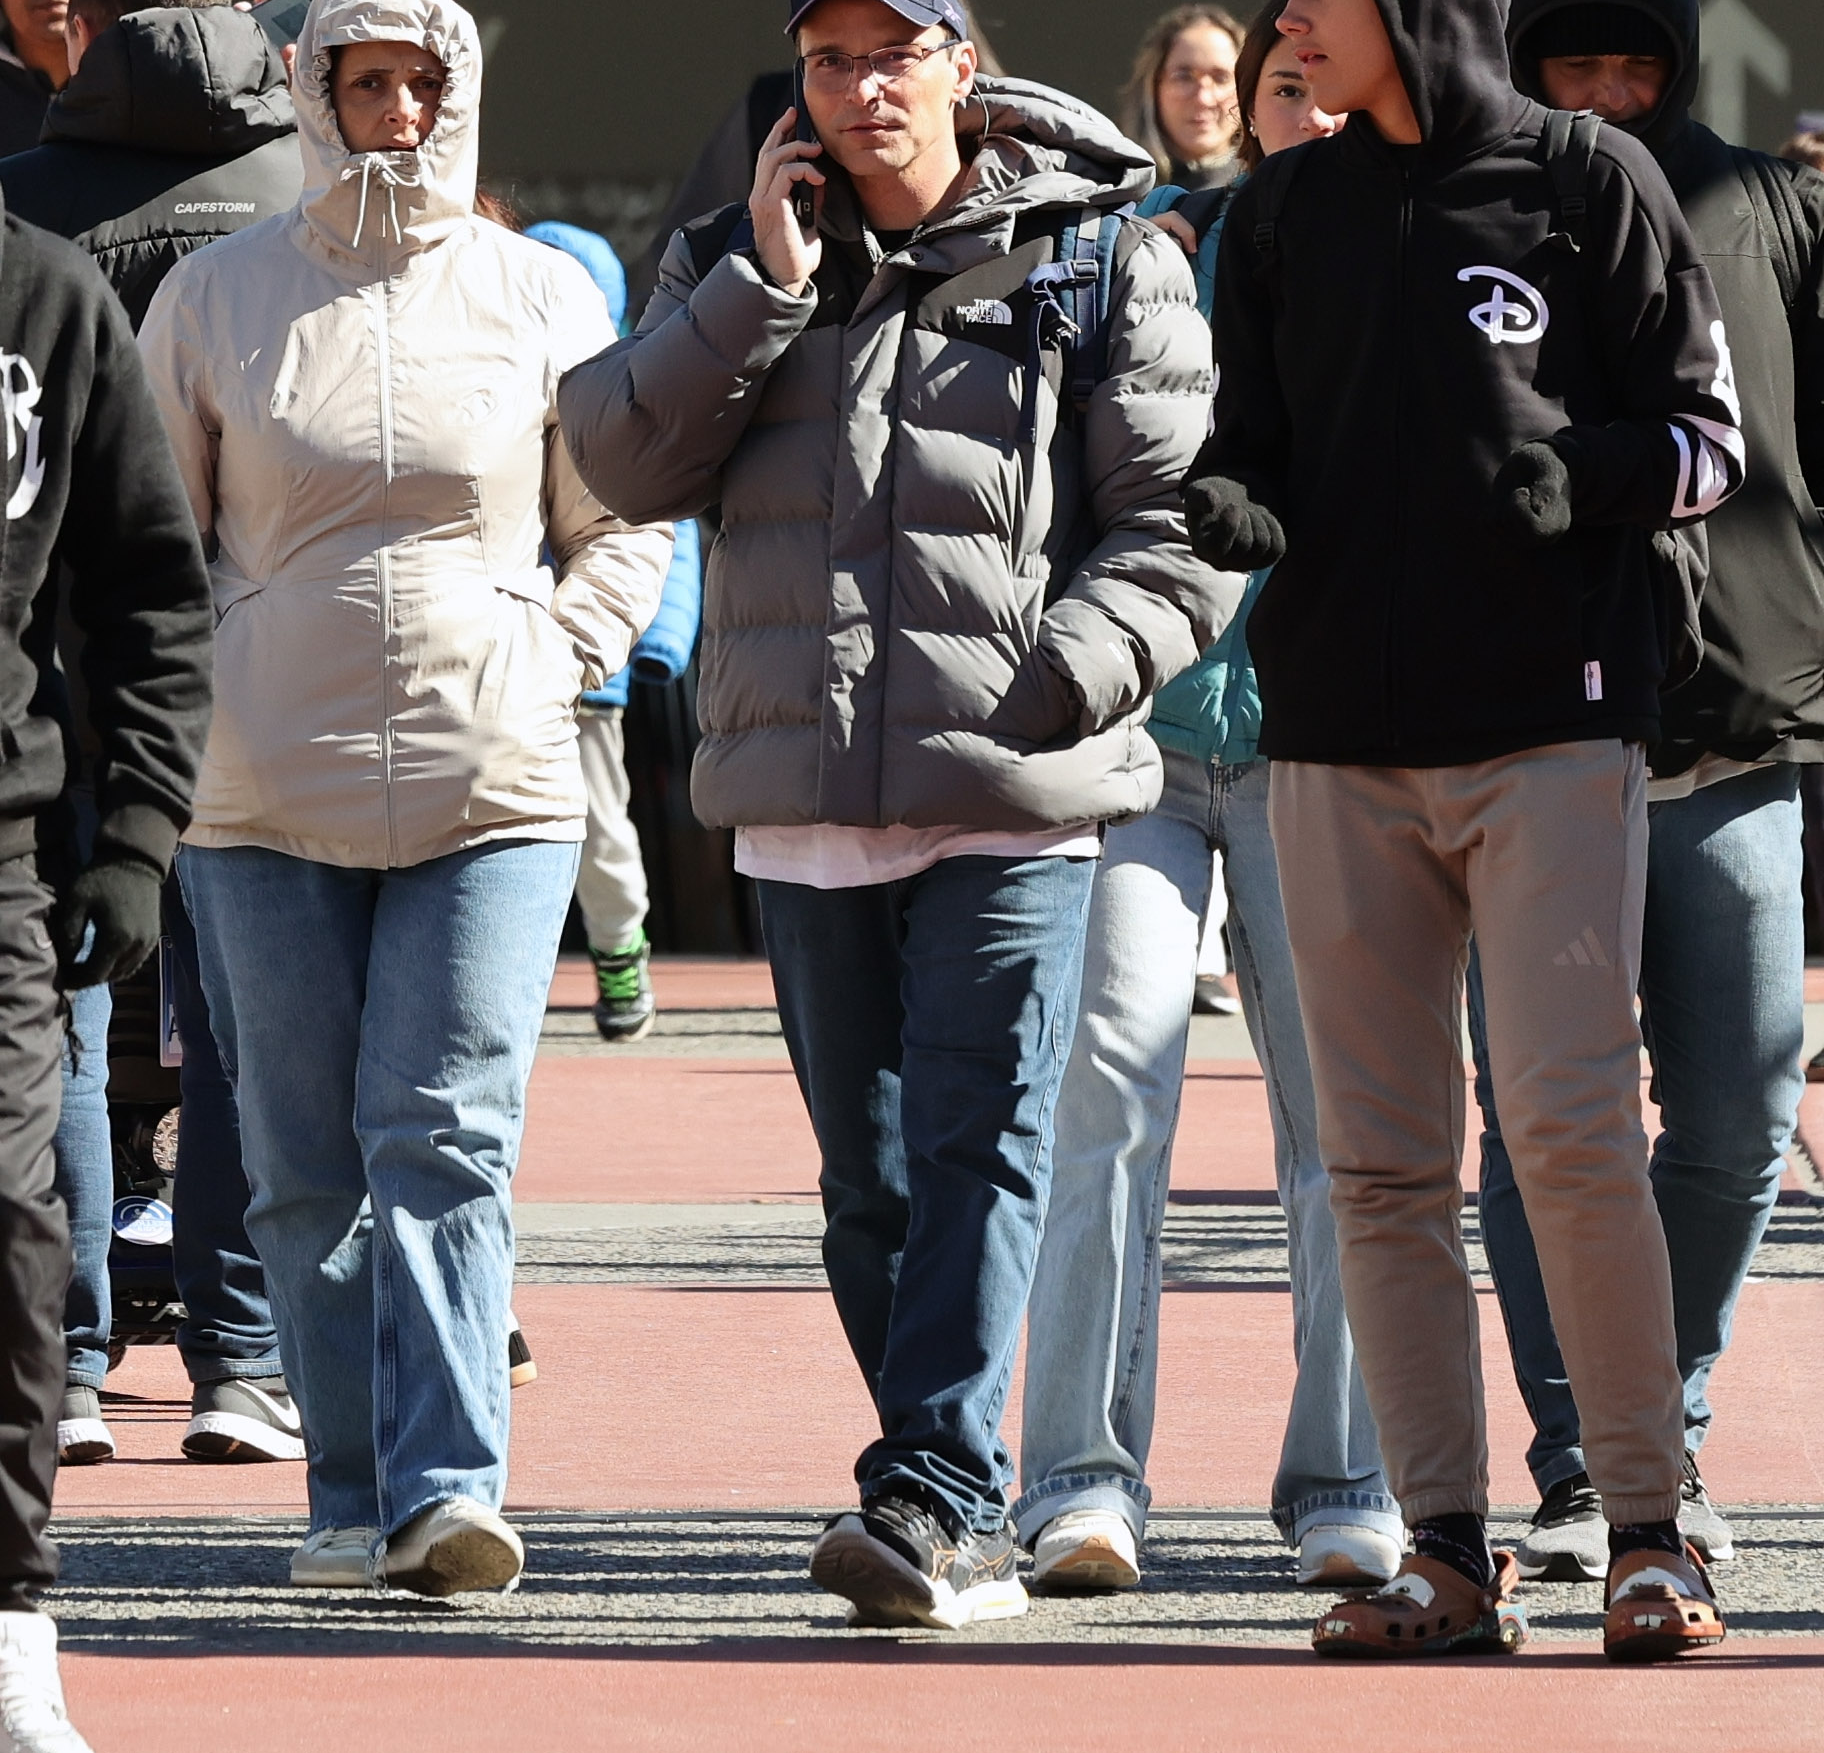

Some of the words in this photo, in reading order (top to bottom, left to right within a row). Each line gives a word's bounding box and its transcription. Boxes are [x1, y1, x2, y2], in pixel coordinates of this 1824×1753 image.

[175, 202, 256, 214] CAPESTORM
[973, 298, 994, 308] THE
[956, 305, 993, 316] NORTH
[966, 314, 992, 324] FACE
